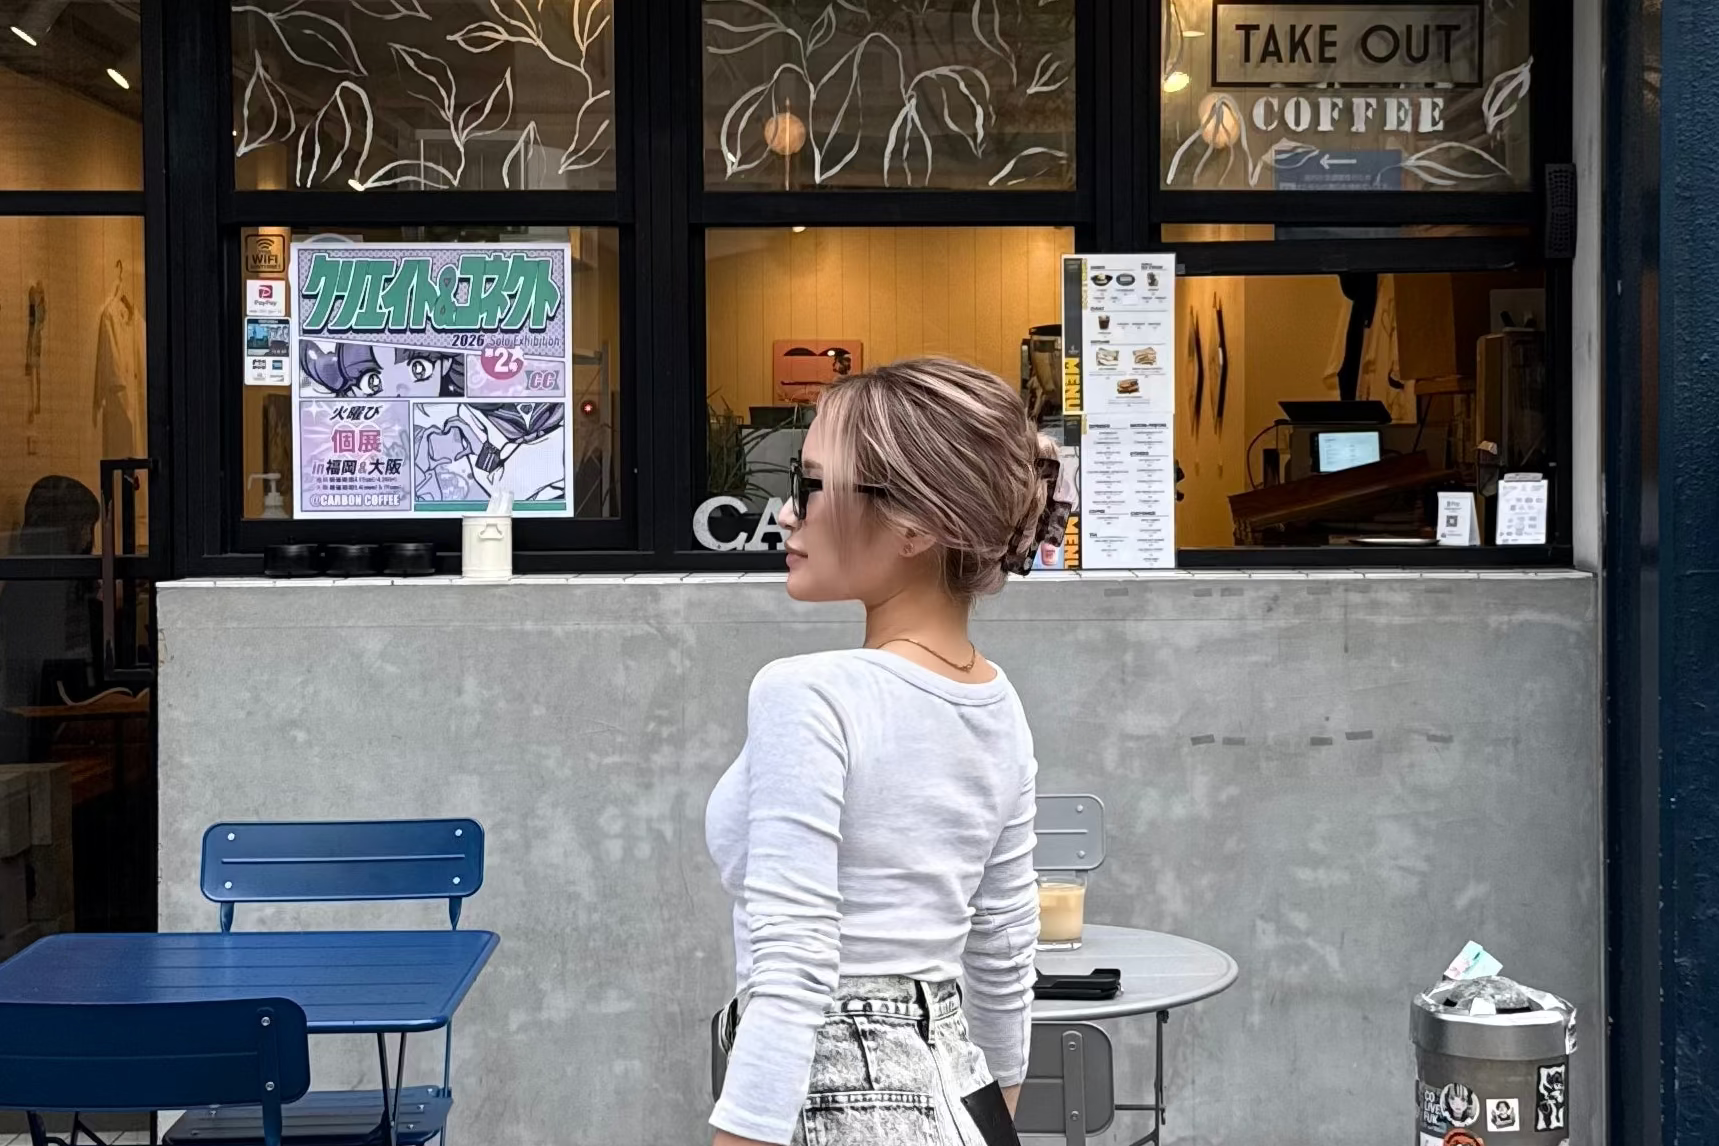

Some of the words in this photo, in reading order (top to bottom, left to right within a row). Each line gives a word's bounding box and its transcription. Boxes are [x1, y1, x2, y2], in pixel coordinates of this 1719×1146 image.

[1234, 24, 1338, 64] TAKE
[1360, 24, 1461, 64] OUT
[1252, 96, 1445, 133] COFFEE
[452, 334, 485, 347] 2026
[514, 334, 560, 347] Exhibition
[1065, 358, 1081, 411] MENU
[331, 429, 382, 453] 個展
[364, 494, 401, 507] COFFEE
